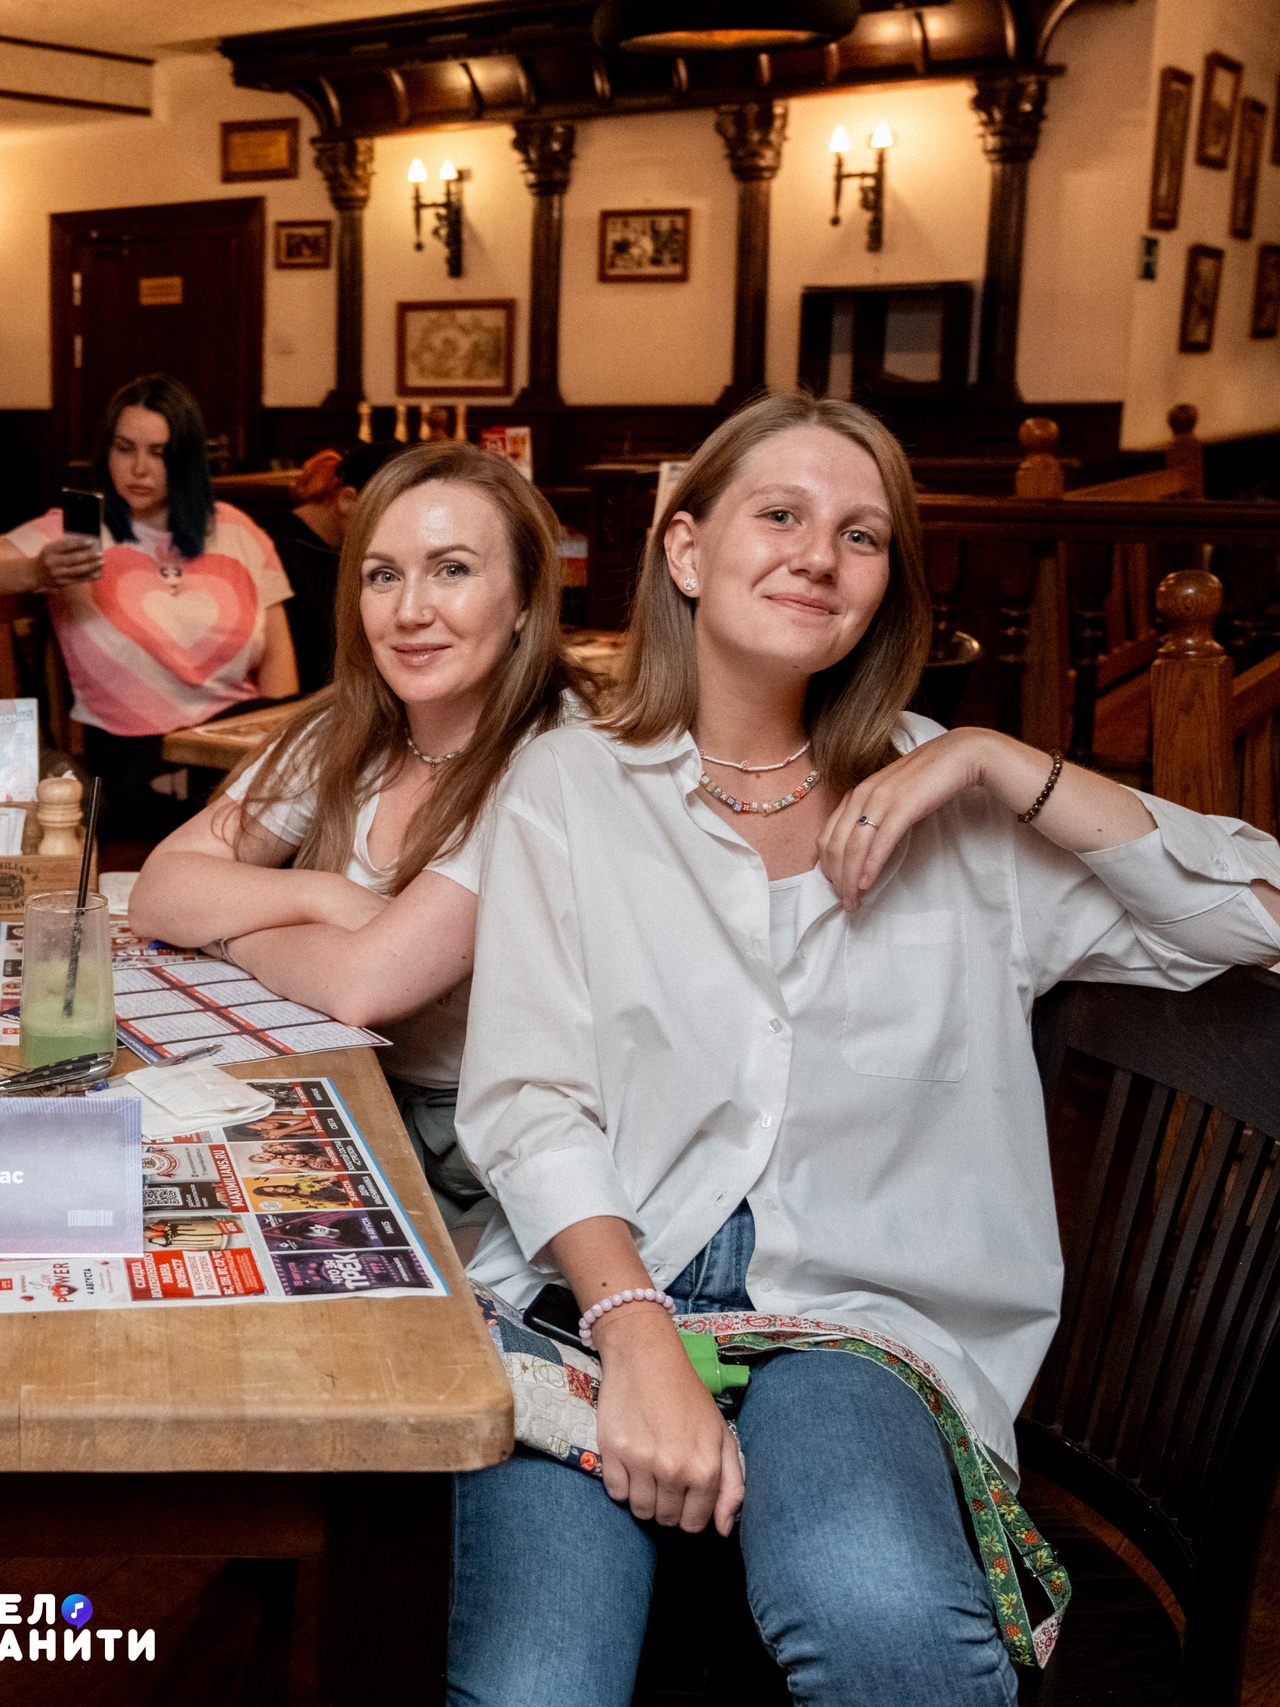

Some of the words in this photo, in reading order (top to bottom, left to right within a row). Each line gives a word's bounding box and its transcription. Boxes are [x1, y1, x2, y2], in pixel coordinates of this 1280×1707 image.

[326, 1117, 339, 1130] СВЕТА
[213, 1149, 245, 1207] MAXIMILIANS.RU
[131, 1262, 146, 1288] СКИДКА
[159, 1263, 173, 1283] РАВНА
[171, 1258, 189, 1288] ВОЗРАСТУ
[323, 1259, 336, 1270] ЗА
[332, 1253, 370, 1290] ТРЕК
[83, 1268, 93, 1290] АВГУСТА
[328, 1269, 344, 1285] ЧТО
